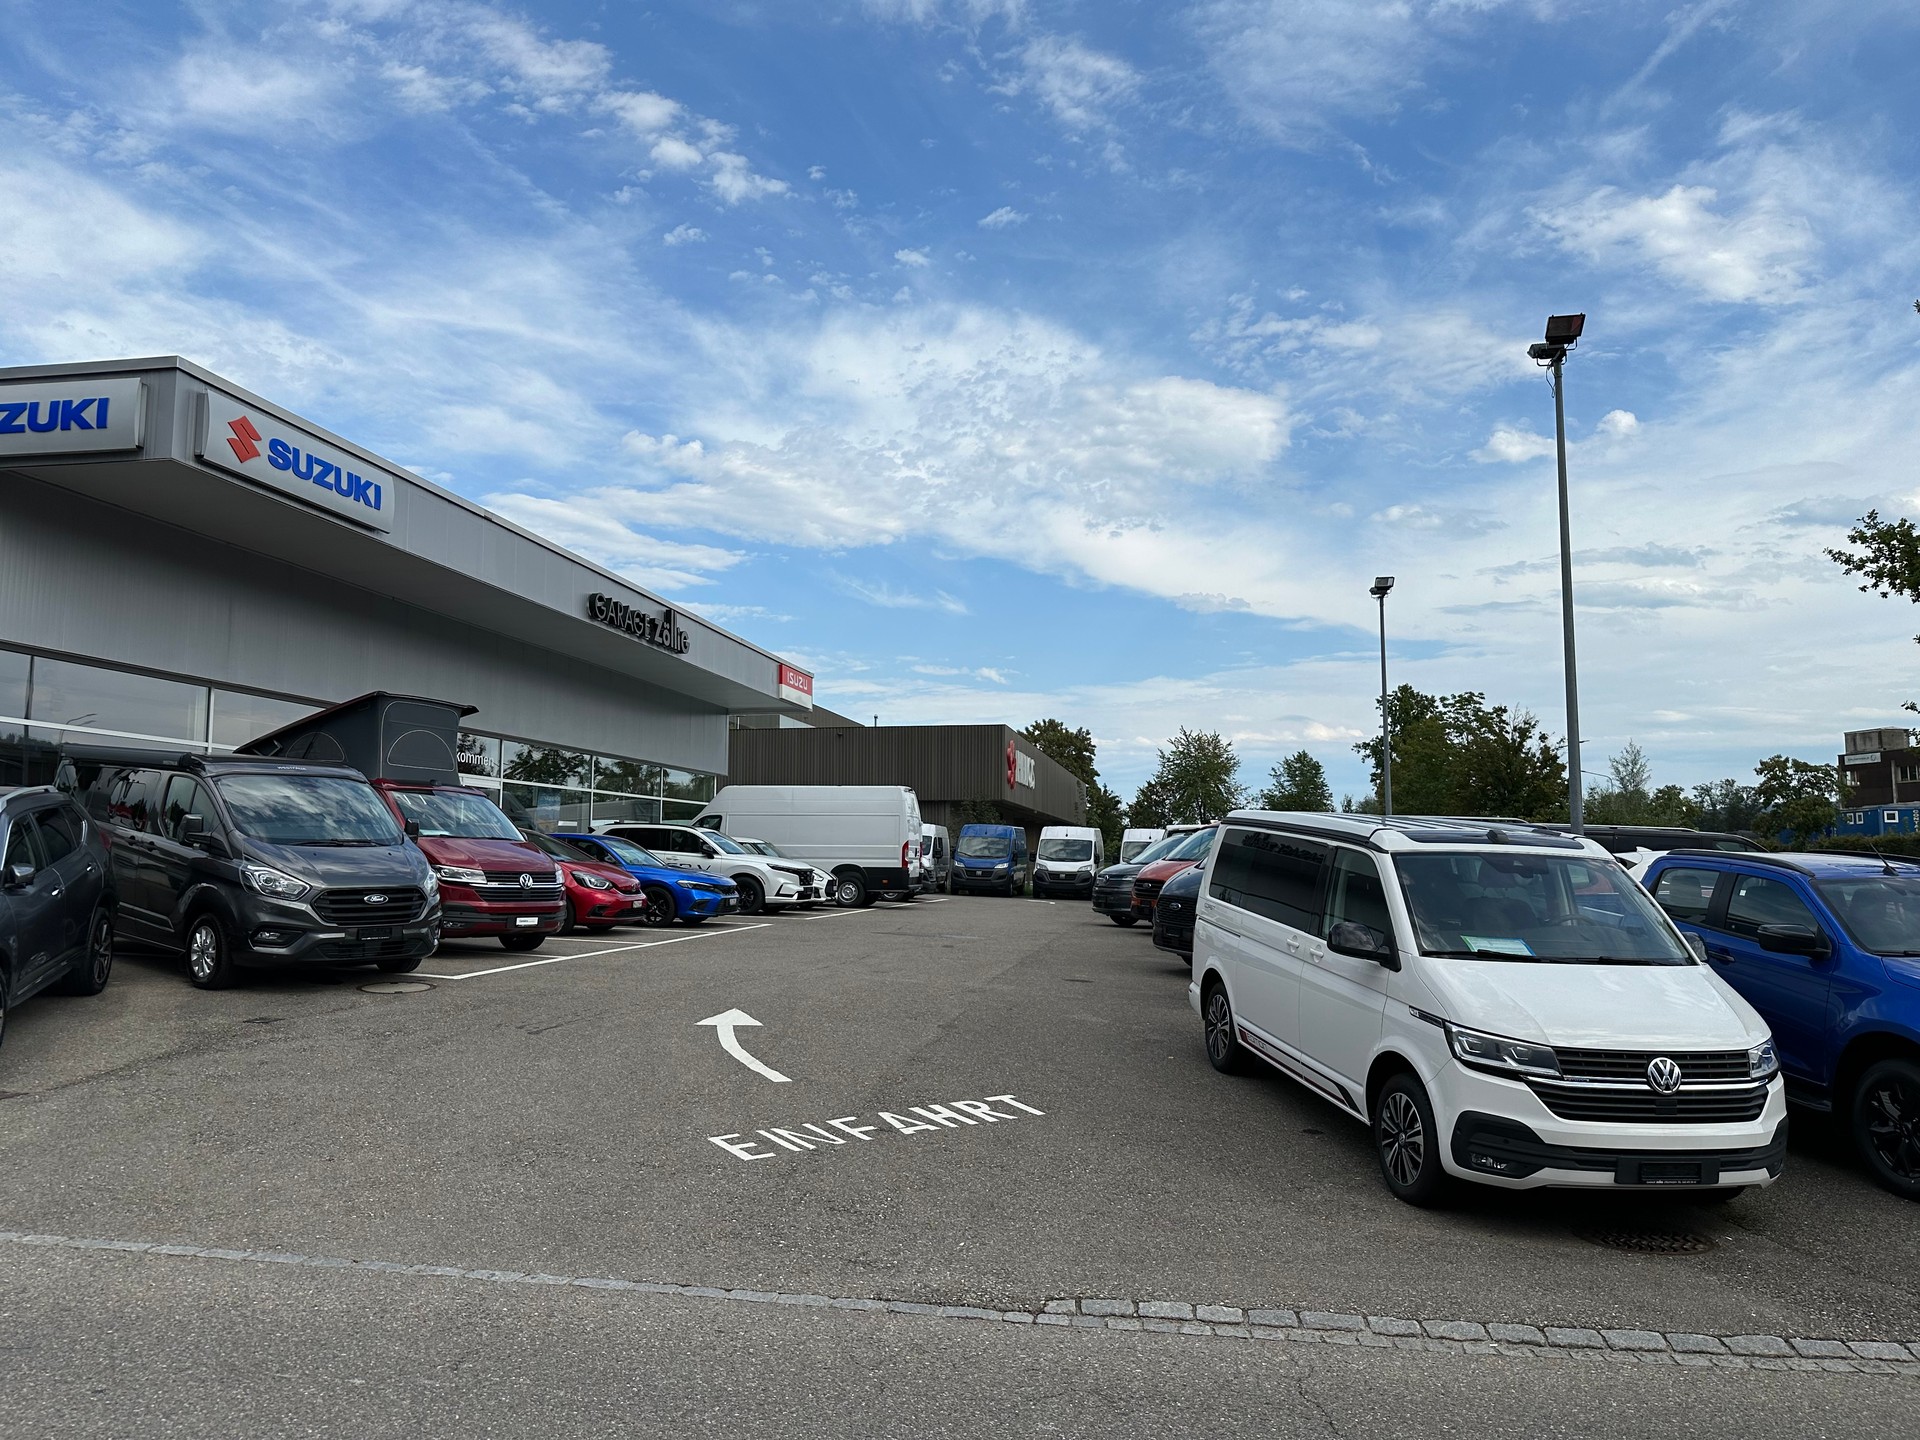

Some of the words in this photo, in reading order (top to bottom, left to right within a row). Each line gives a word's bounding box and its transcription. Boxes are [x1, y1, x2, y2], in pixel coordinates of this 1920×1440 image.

[267, 438, 382, 511] SUZUKI
[589, 592, 651, 640] GARAGE
[786, 670, 808, 691] ISUZU
[707, 1094, 1046, 1161] EINFAHRT
